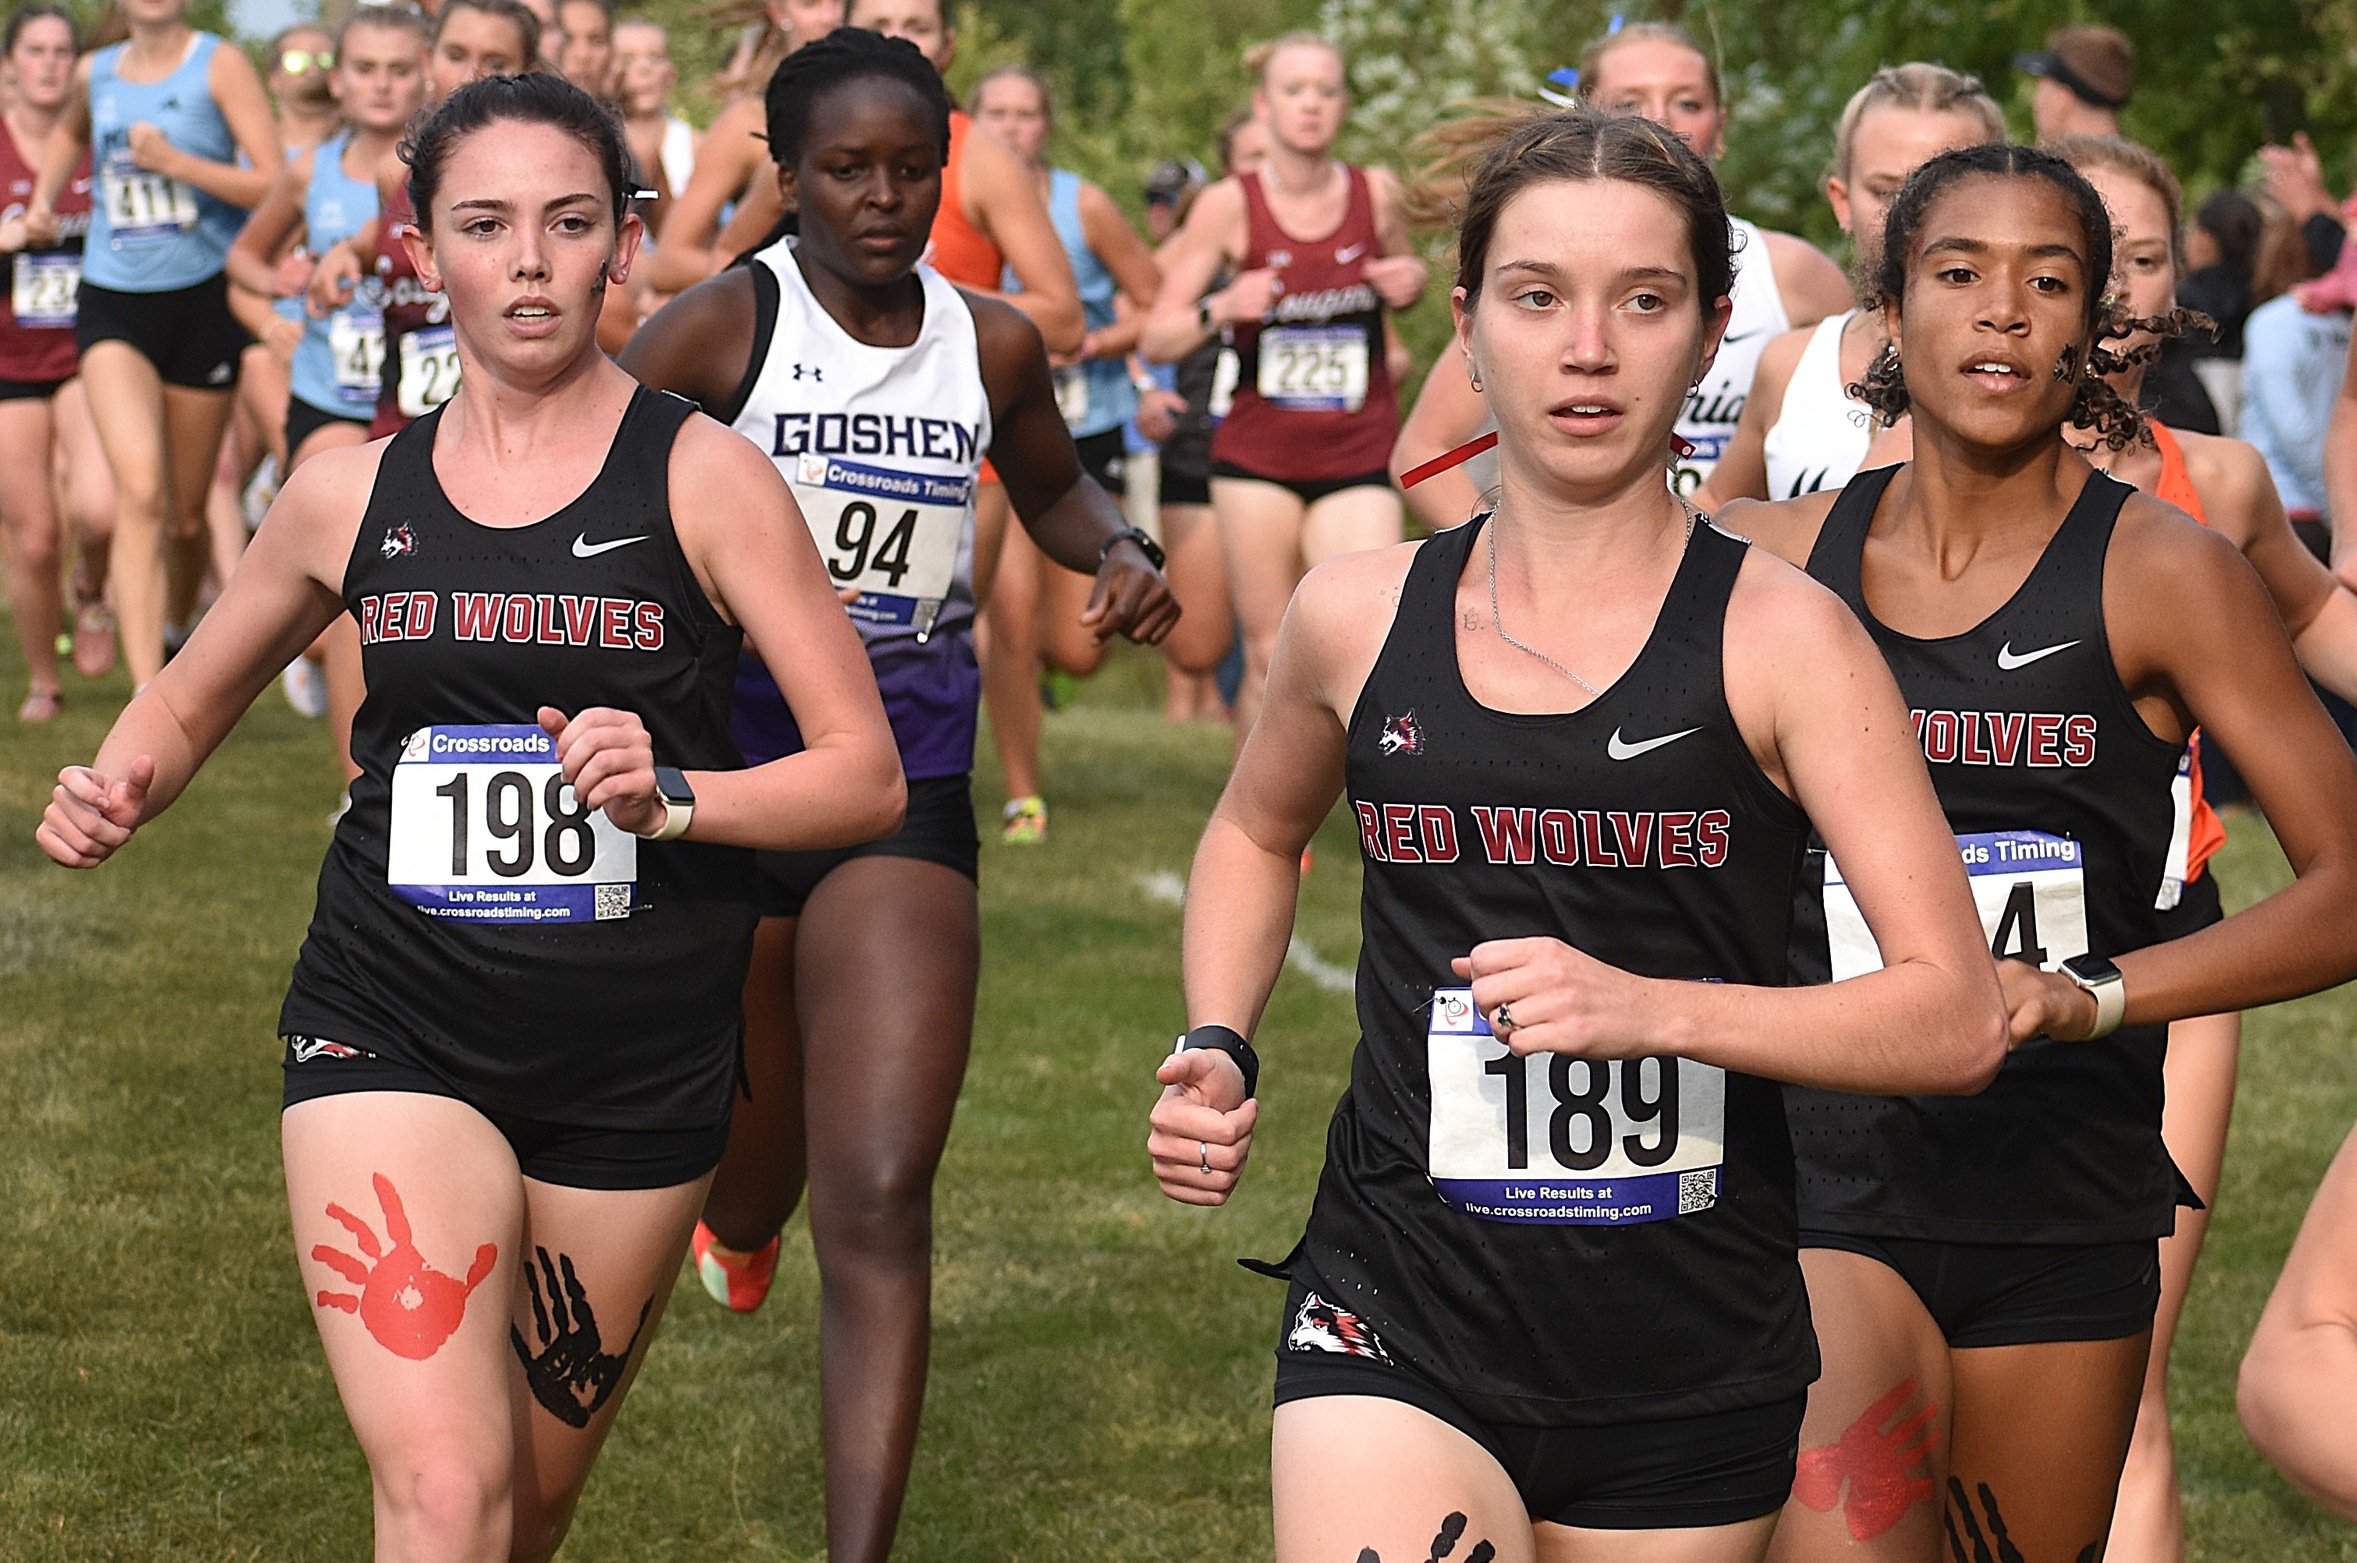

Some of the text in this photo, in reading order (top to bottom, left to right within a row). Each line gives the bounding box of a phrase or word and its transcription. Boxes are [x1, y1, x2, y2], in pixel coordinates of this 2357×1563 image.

[1278, 347, 1348, 391] 225
[773, 413, 980, 463] GOSHEN
[827, 465, 920, 495] Crossroads
[828, 501, 919, 588] 94
[361, 591, 664, 650] RED WOLVES
[432, 734, 551, 754] Crossroads
[436, 771, 596, 877] 198
[1356, 800, 1731, 869] RED WOLVES
[1994, 838, 2076, 862] Timing
[448, 890, 536, 902] Live Results at
[1484, 1050, 1680, 1171] 189
[1465, 1202, 1652, 1220] live.crossroadstiming.com
[1505, 1186, 1612, 1199] Live Results at
